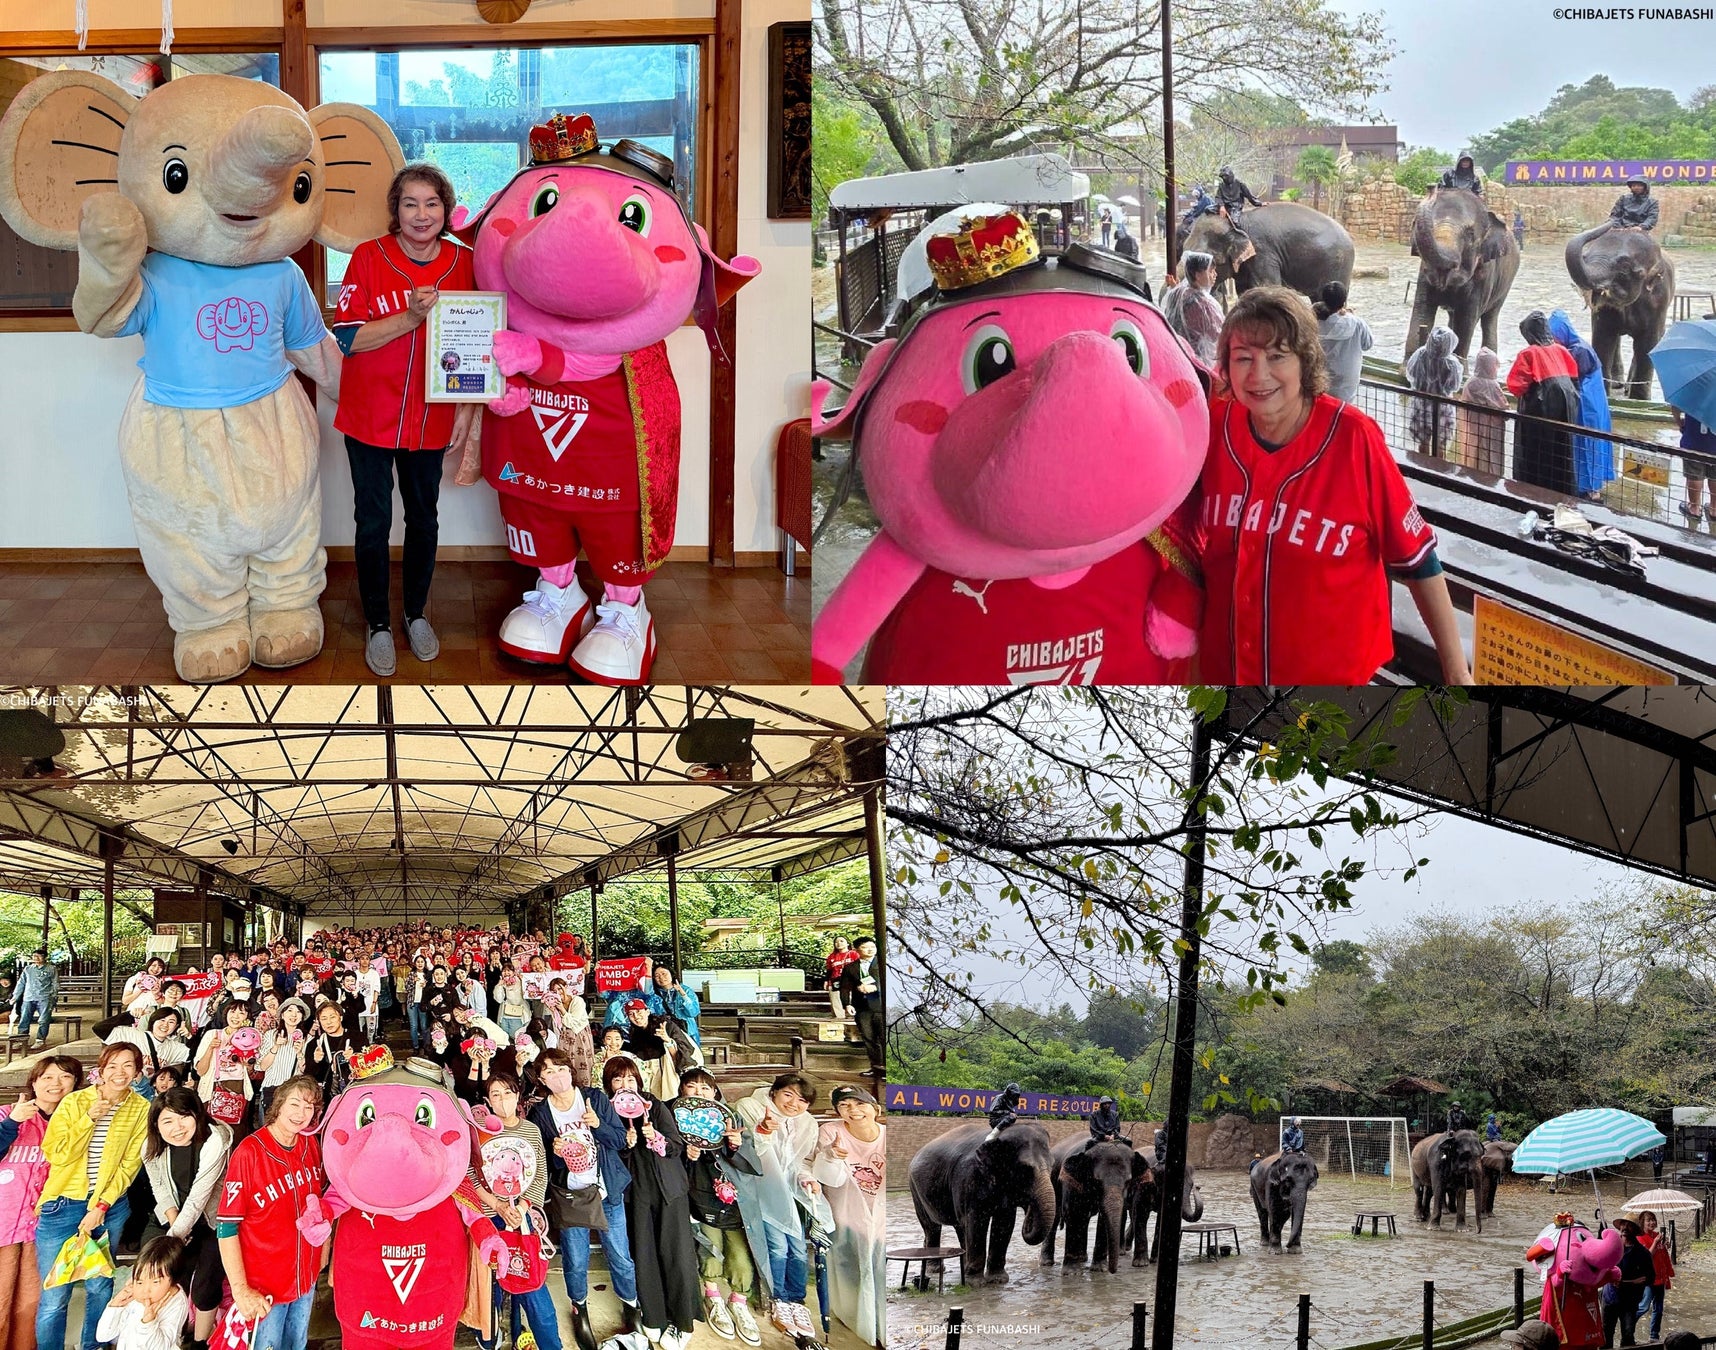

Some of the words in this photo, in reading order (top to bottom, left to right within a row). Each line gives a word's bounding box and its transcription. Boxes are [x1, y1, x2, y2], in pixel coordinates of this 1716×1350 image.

[1537, 165, 1629, 179] ANIMAL
[529, 387, 590, 411] CHIBAJETS
[1006, 628, 1104, 669] CHIBAJETS
[893, 1091, 923, 1106] AL
[939, 1093, 1028, 1111] WONR
[381, 1243, 427, 1258] CHIBAJETS
